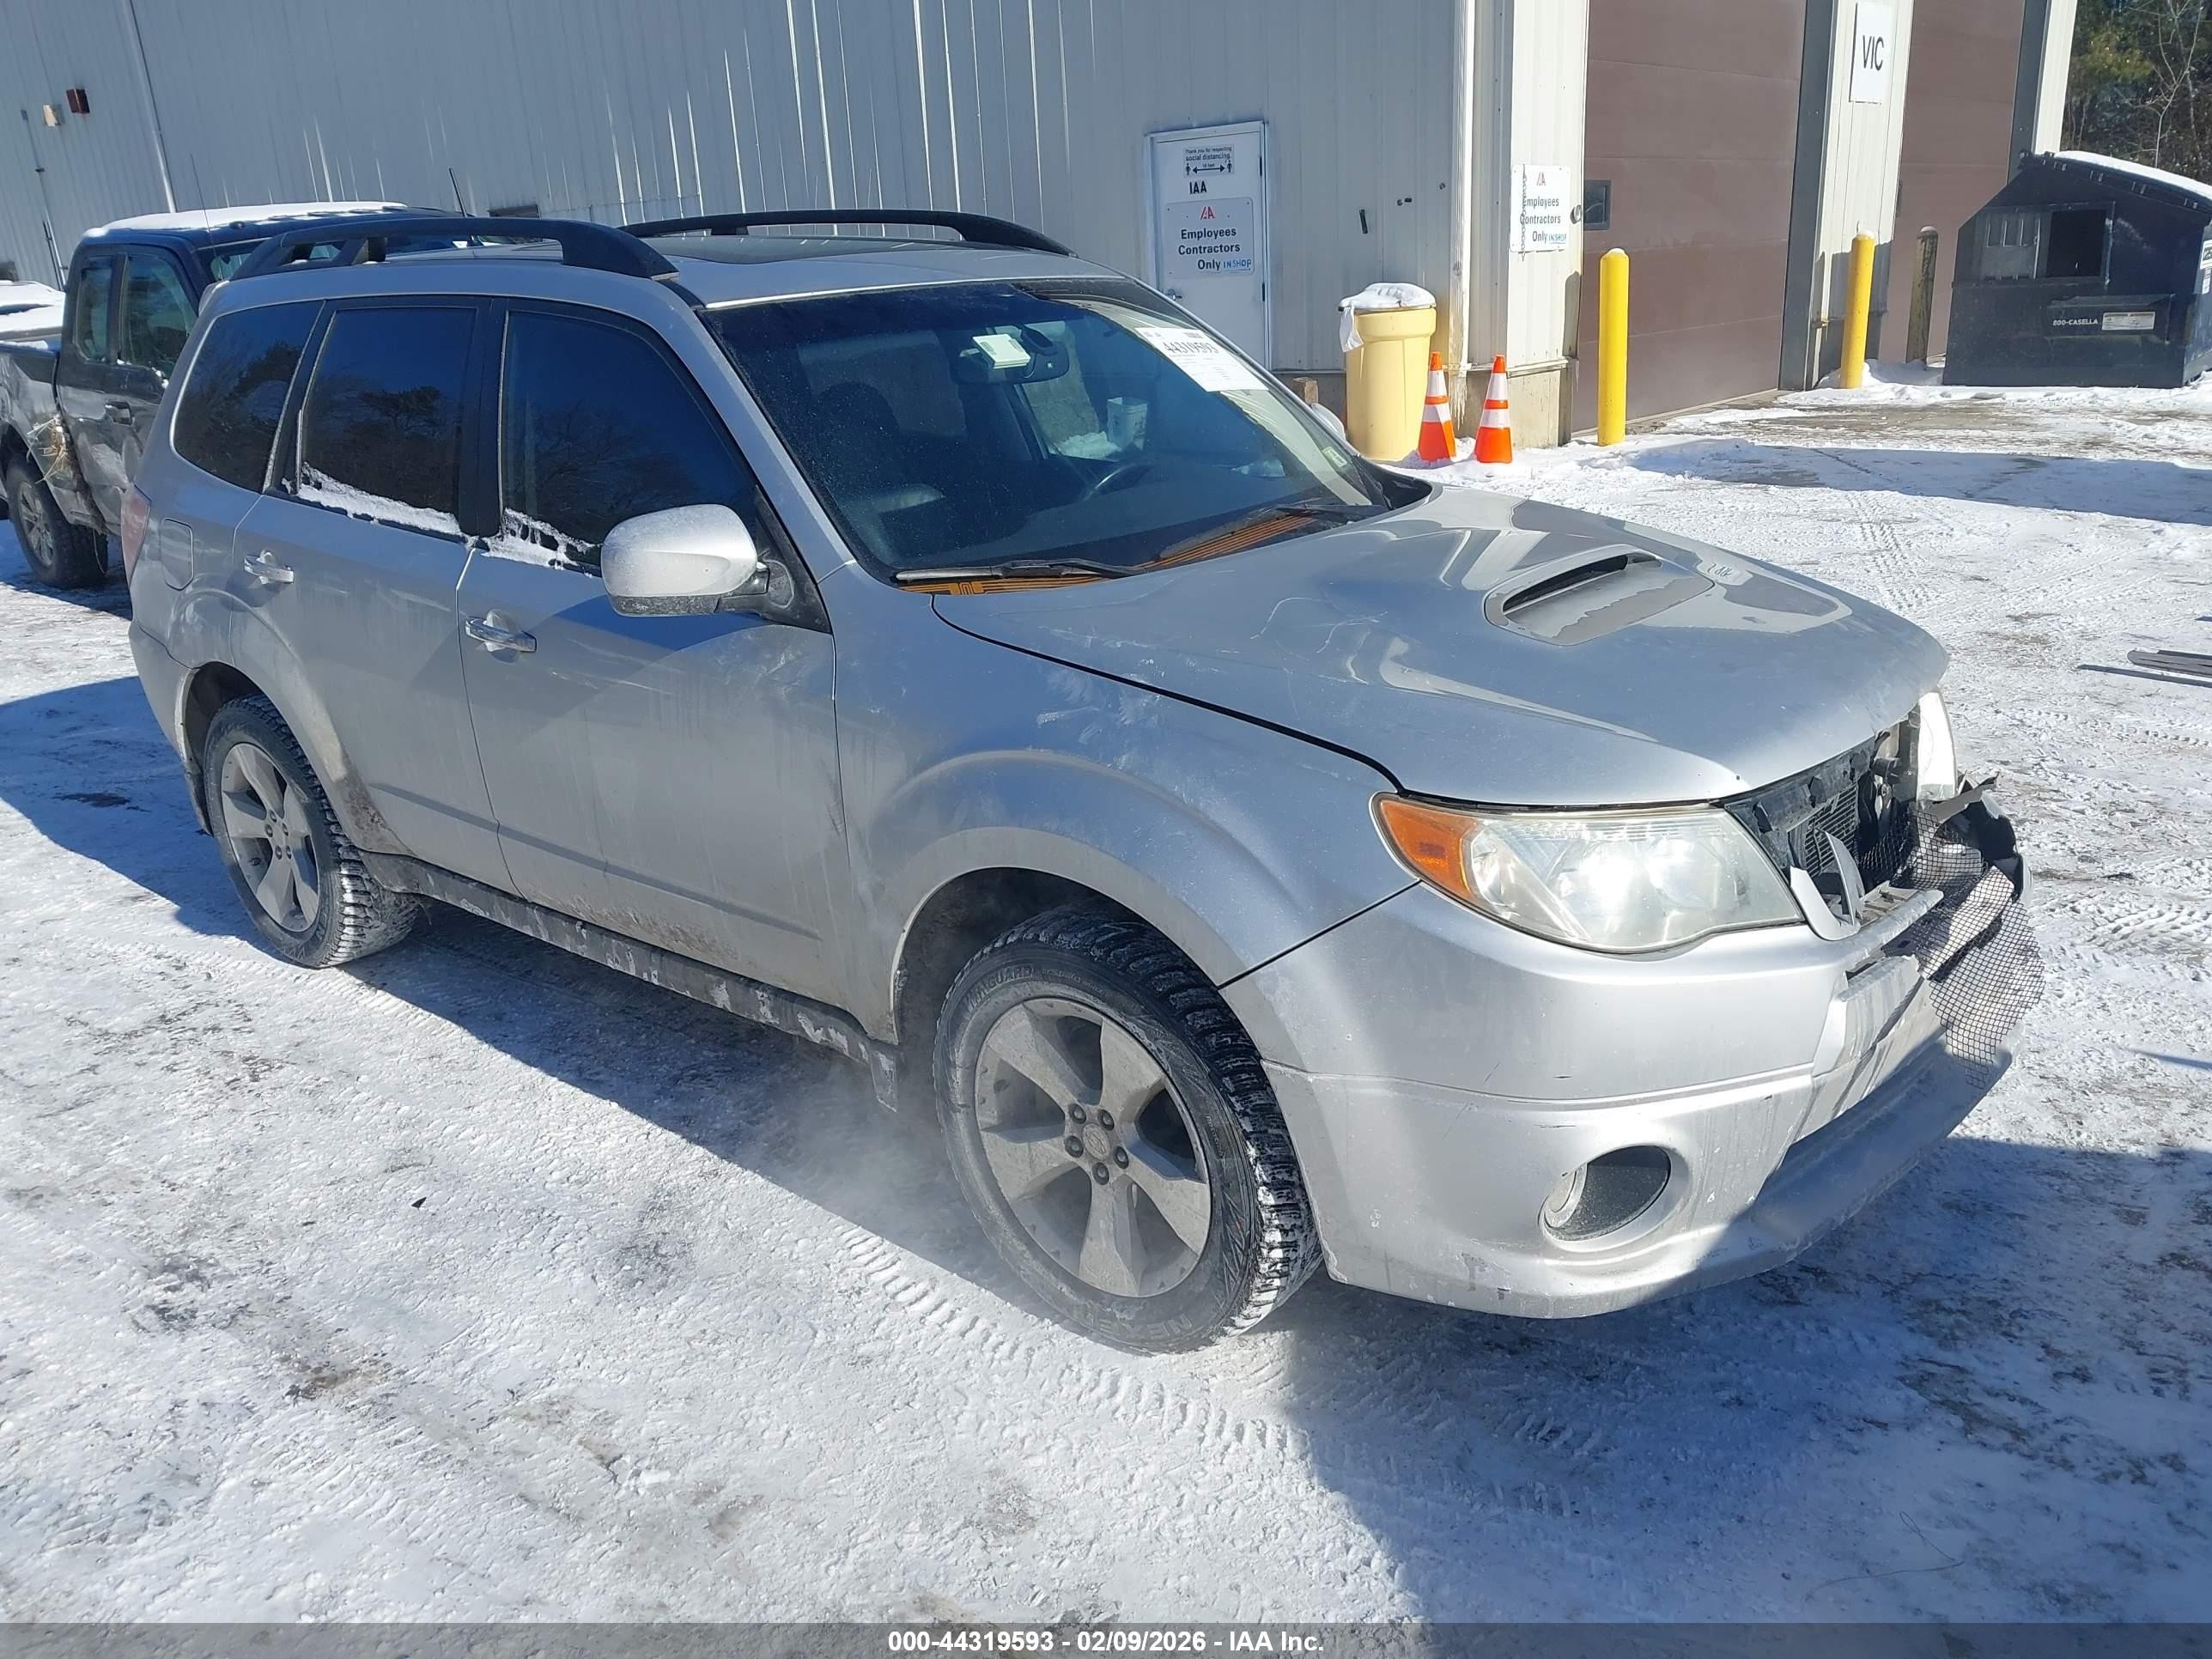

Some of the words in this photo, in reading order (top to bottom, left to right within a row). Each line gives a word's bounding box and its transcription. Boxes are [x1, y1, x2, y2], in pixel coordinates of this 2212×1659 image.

[1863, 34, 1884, 70] VIC
[1189, 180, 1207, 194] IAA
[1181, 228, 1237, 240] Employees
[1532, 230, 1547, 244] Only
[1178, 244, 1240, 255] Contractors
[1198, 259, 1221, 271] Only
[1163, 342, 1219, 354] 44319593
